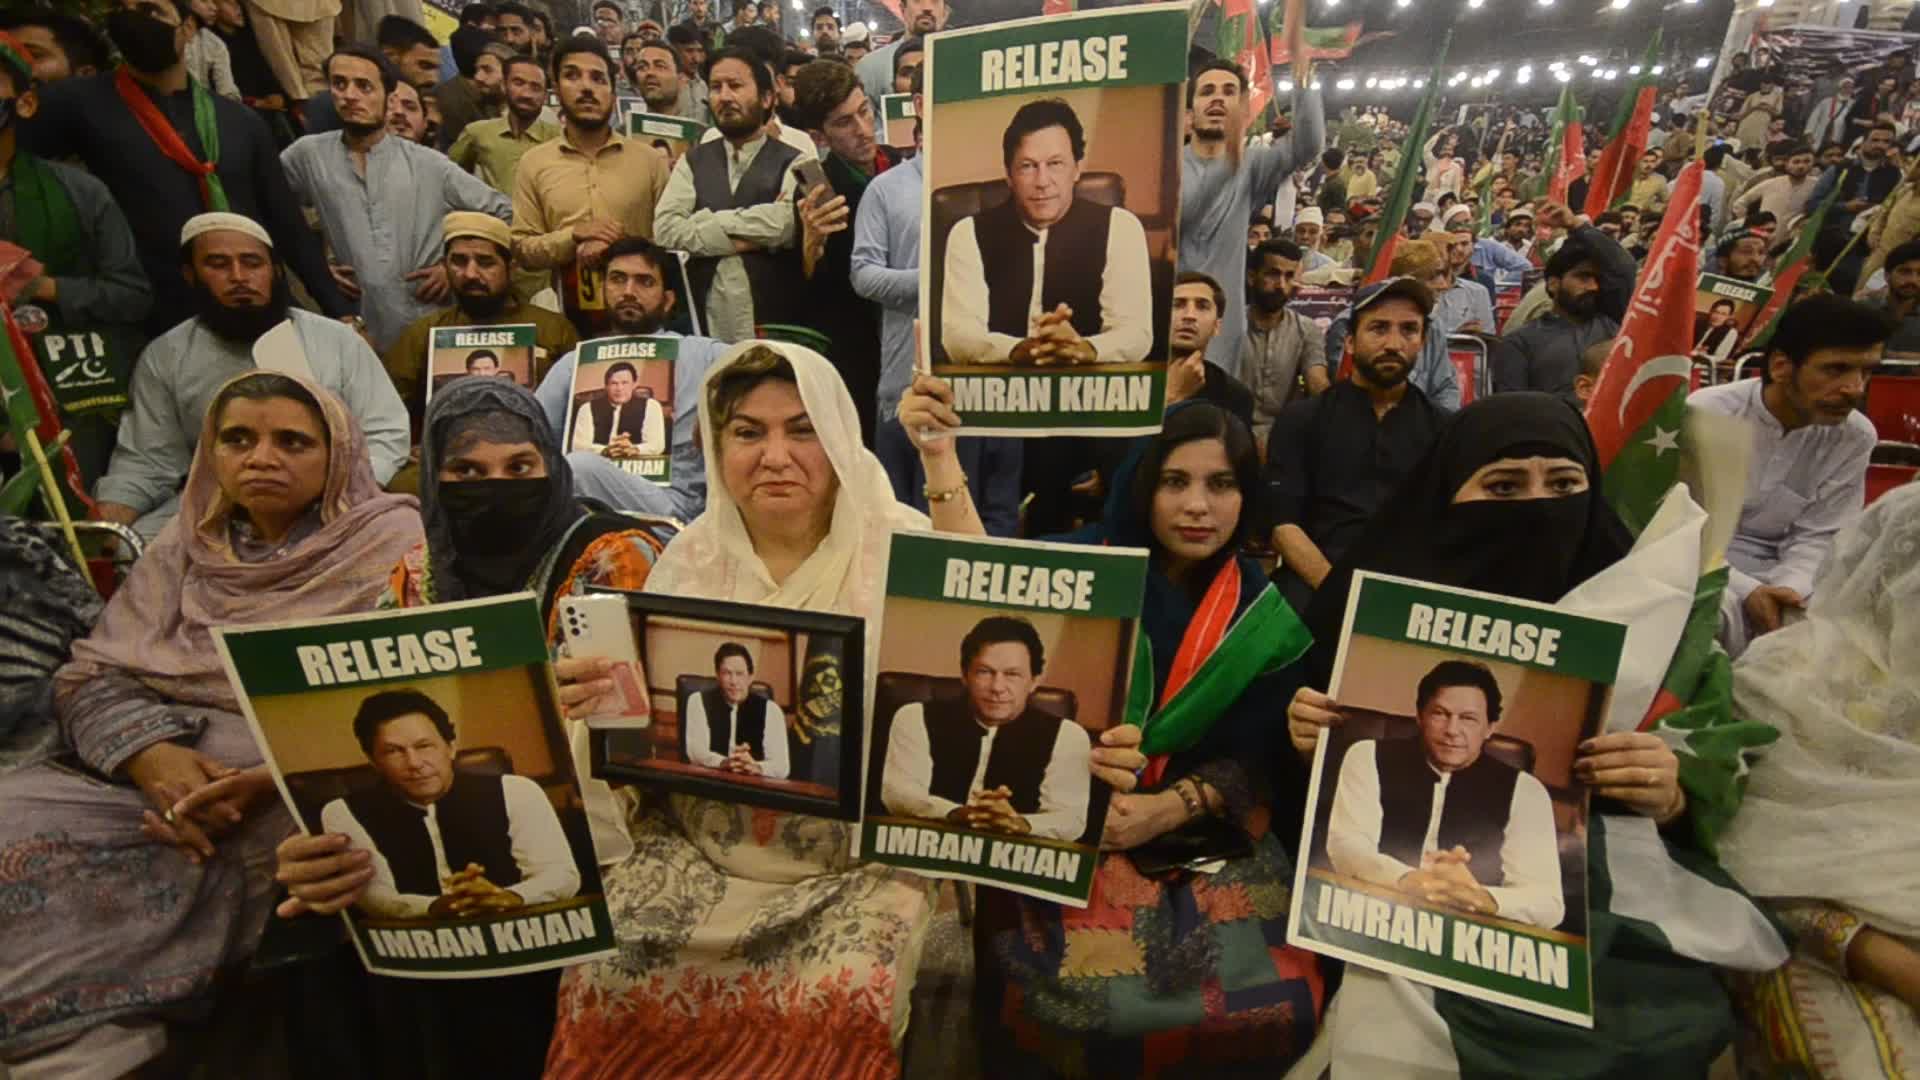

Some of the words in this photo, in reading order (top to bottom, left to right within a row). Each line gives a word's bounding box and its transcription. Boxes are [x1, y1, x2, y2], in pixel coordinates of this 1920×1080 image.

[981, 35, 1128, 92] RELEASE
[44, 332, 105, 361] PTI
[455, 332, 515, 346] RELEASE
[597, 343, 656, 360] RELEASE
[940, 376, 1051, 412] MRAN
[1059, 375, 1152, 412] KHAN
[943, 558, 1095, 611] RELEASE
[296, 626, 482, 686] RELEASE
[1405, 602, 1562, 667] RELEASE
[875, 825, 984, 865] IMRAN
[989, 841, 1081, 883] KHAN
[368, 925, 488, 959] IMRAN
[490, 907, 596, 953] KHAN
[1317, 884, 1444, 957] IMRAN
[1453, 920, 1569, 989] KHAN
